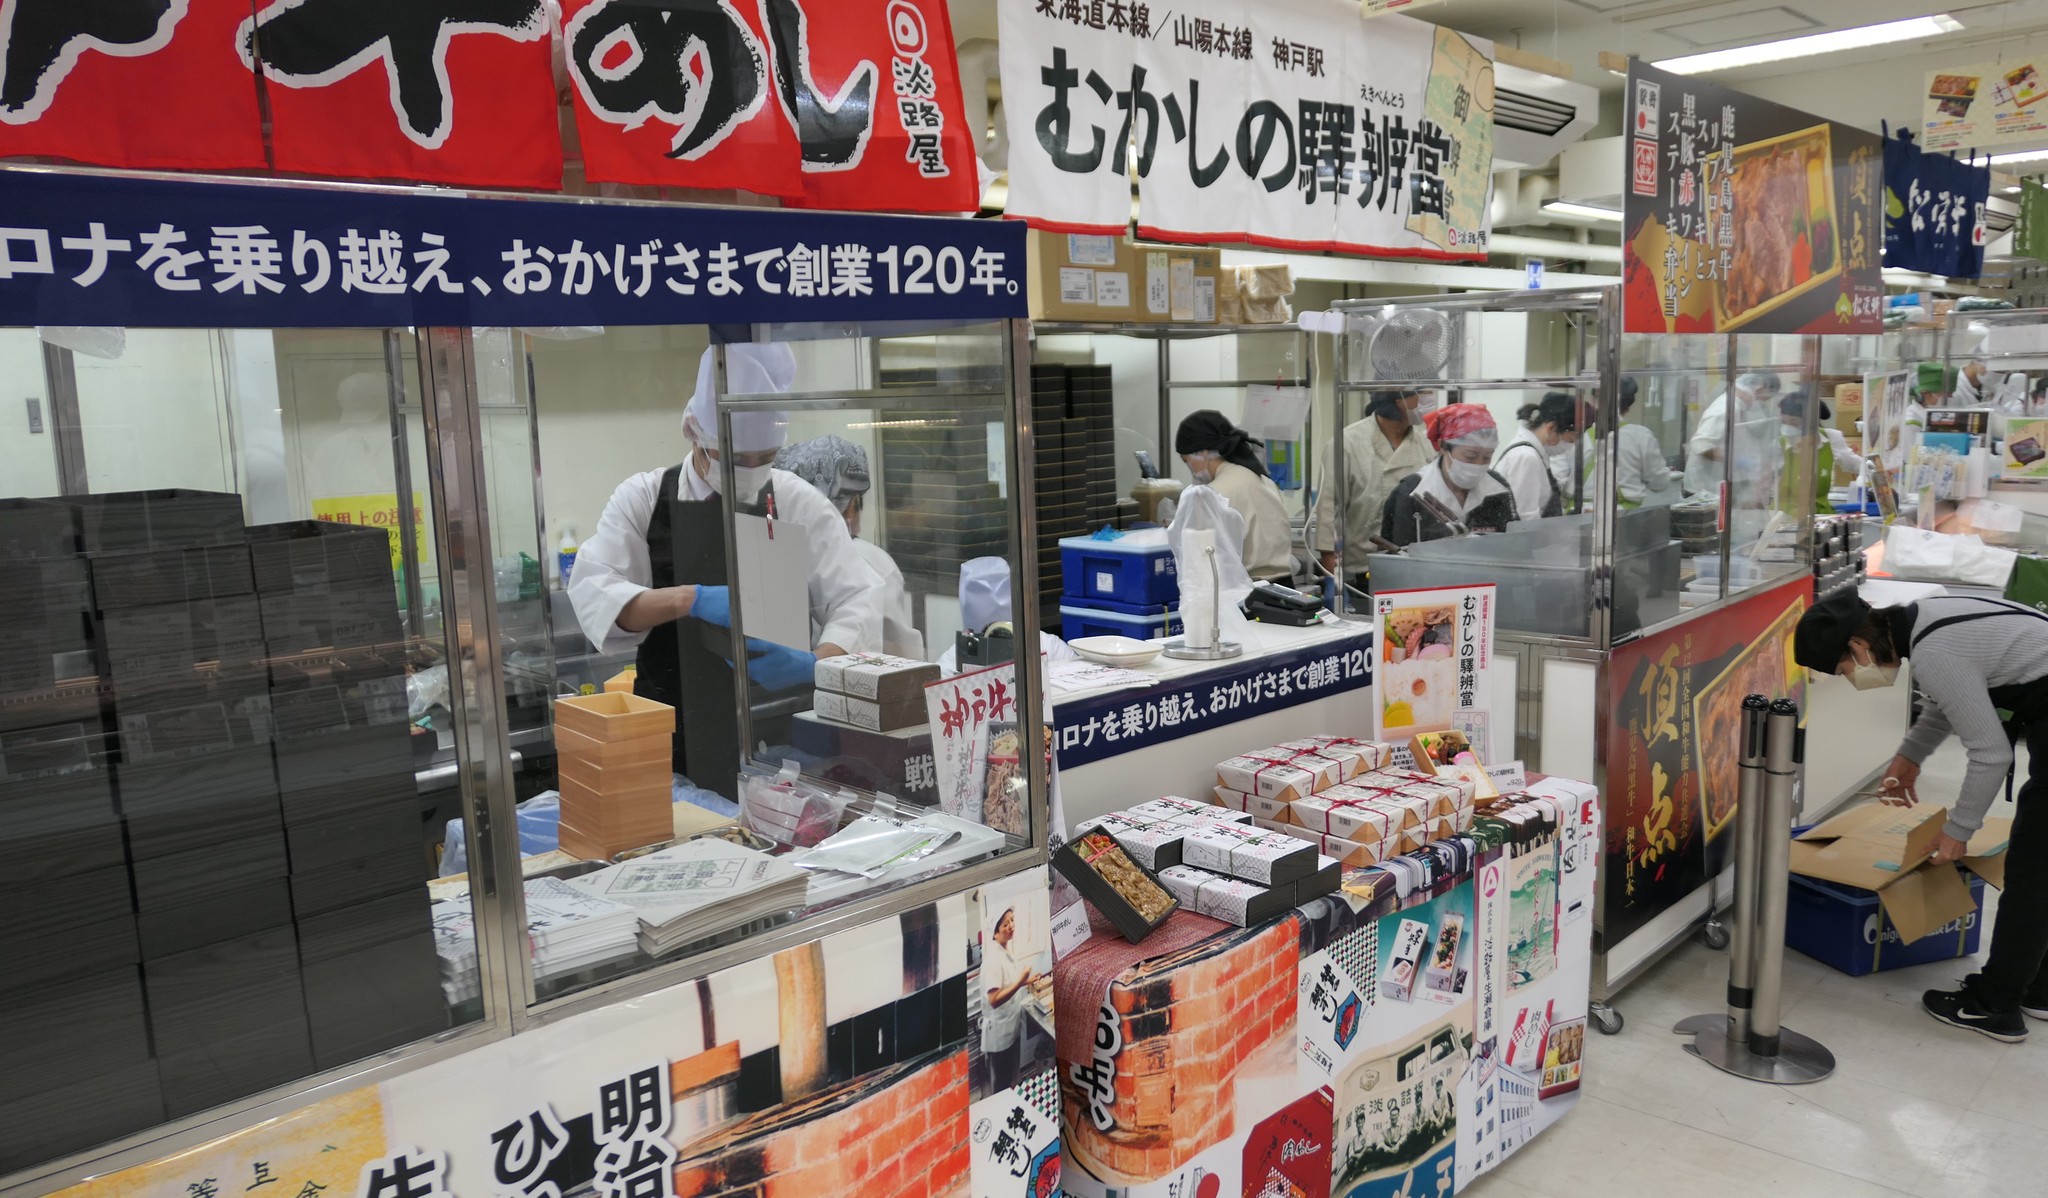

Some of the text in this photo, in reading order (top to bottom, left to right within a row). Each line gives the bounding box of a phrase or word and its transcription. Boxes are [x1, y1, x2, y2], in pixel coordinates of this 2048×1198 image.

[893, 58, 947, 175] 淡路屋
[1272, 36, 1325, 78] 神戸駅
[1360, 84, 1405, 109] えきべんとう
[1664, 111, 1680, 317] ステーキ弁当
[1678, 93, 1696, 298] 黒豚赤ワイン
[1695, 119, 1709, 280] ステーキと
[1707, 122, 1719, 280] リブロース
[1718, 104, 1736, 281] 鹿児島黒牛
[904, 755, 938, 793] 戦
[939, 677, 1017, 739] 神戸牛
[1640, 642, 1680, 869] 頂点
